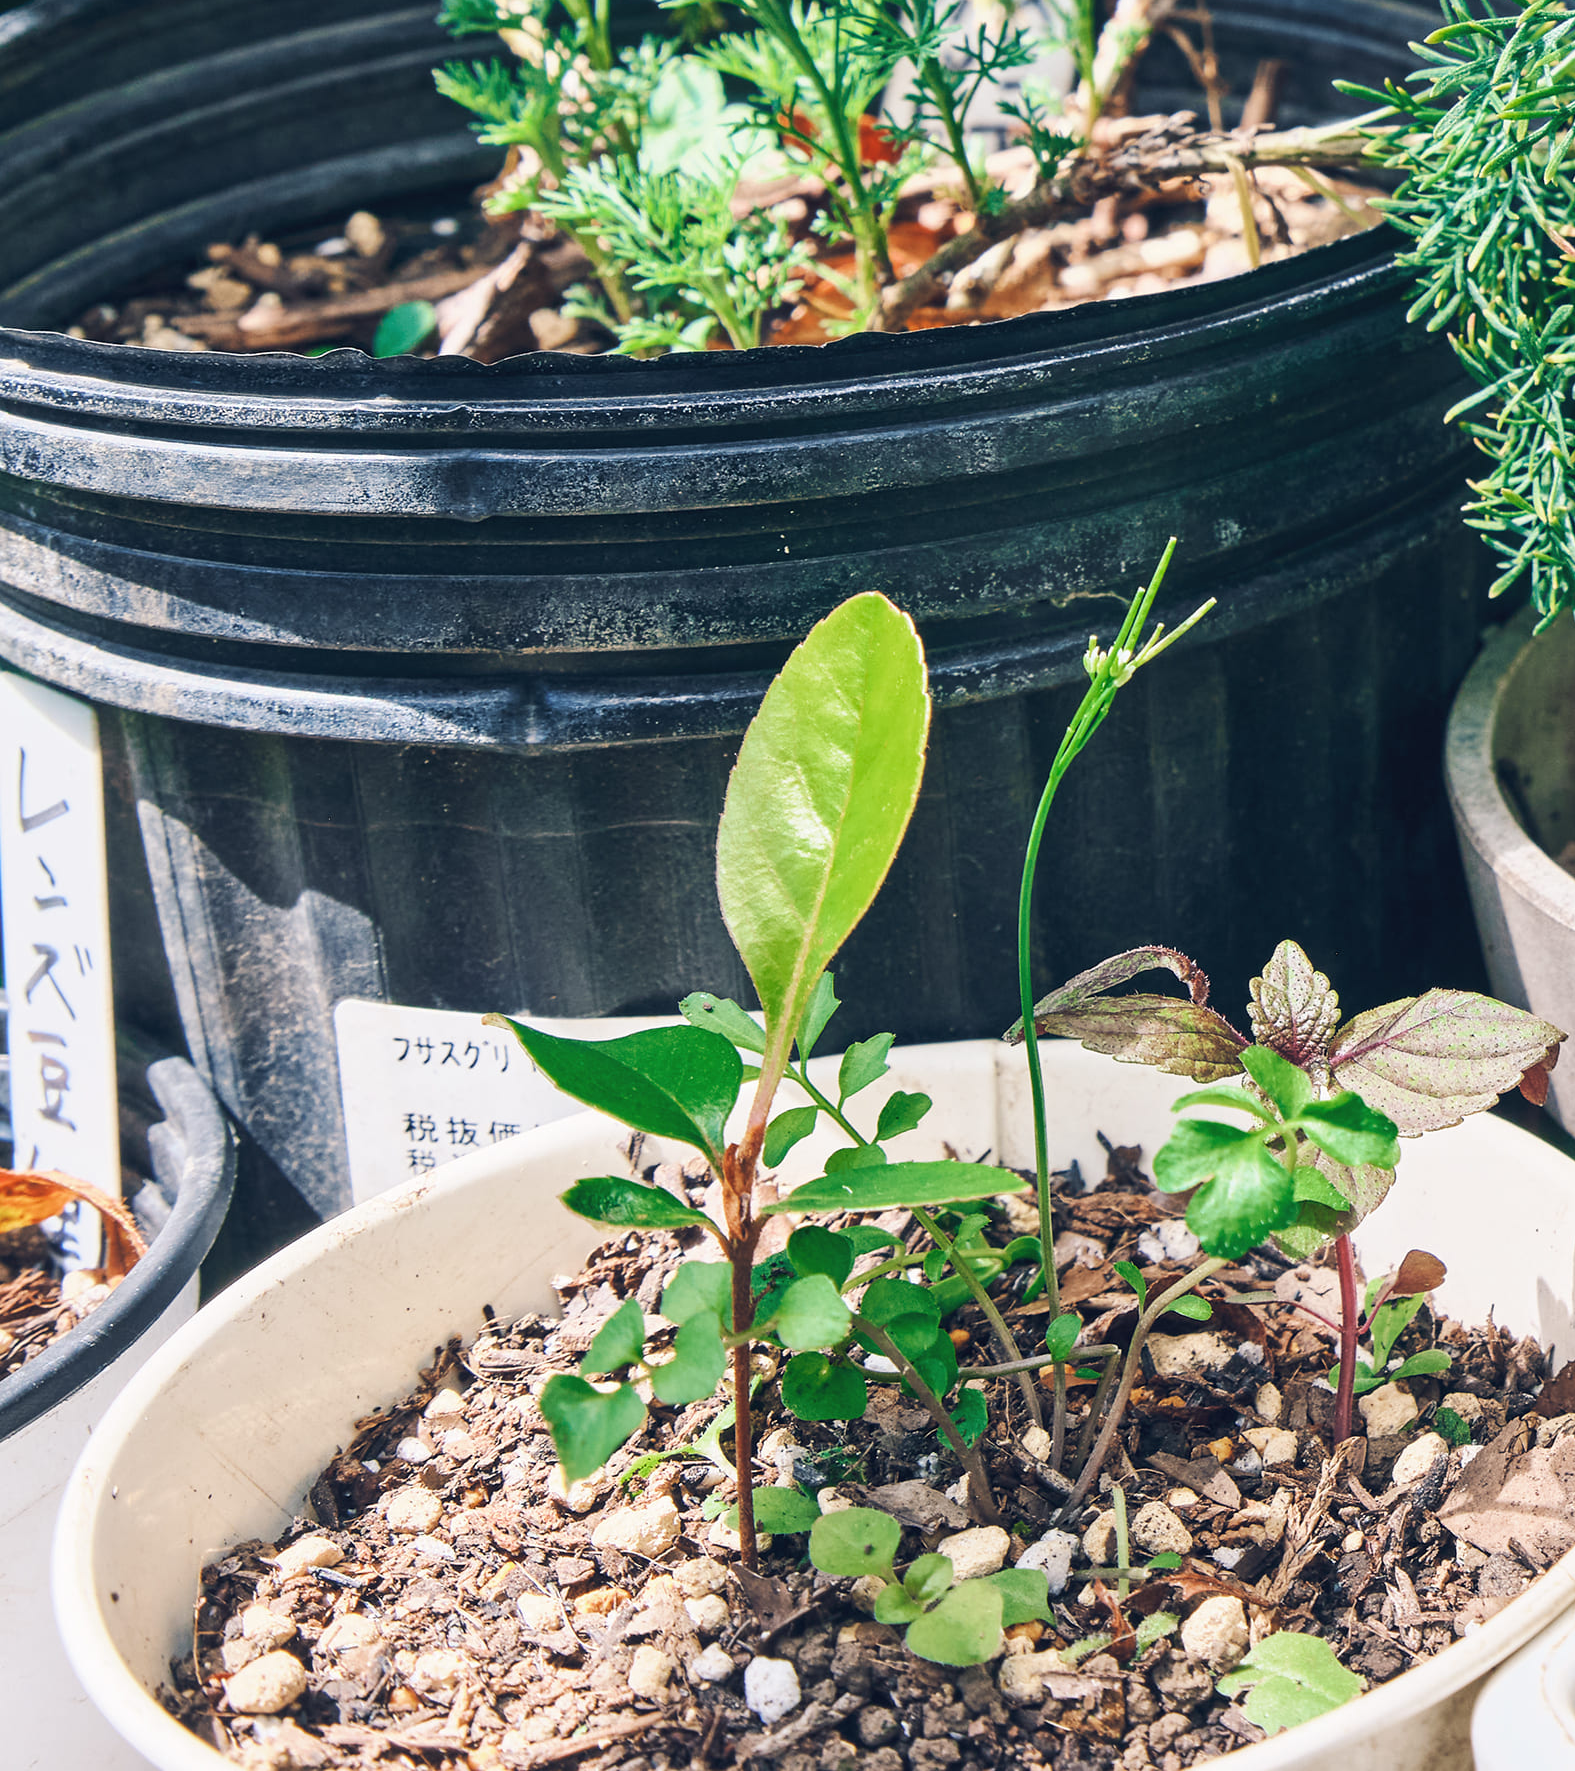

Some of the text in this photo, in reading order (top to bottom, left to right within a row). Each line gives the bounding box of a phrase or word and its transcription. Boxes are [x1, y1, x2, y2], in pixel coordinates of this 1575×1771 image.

[18, 745, 96, 1173] レンズ豆
[393, 1037, 537, 1073] フサスグリ
[402, 1112, 540, 1147] 税抜価
